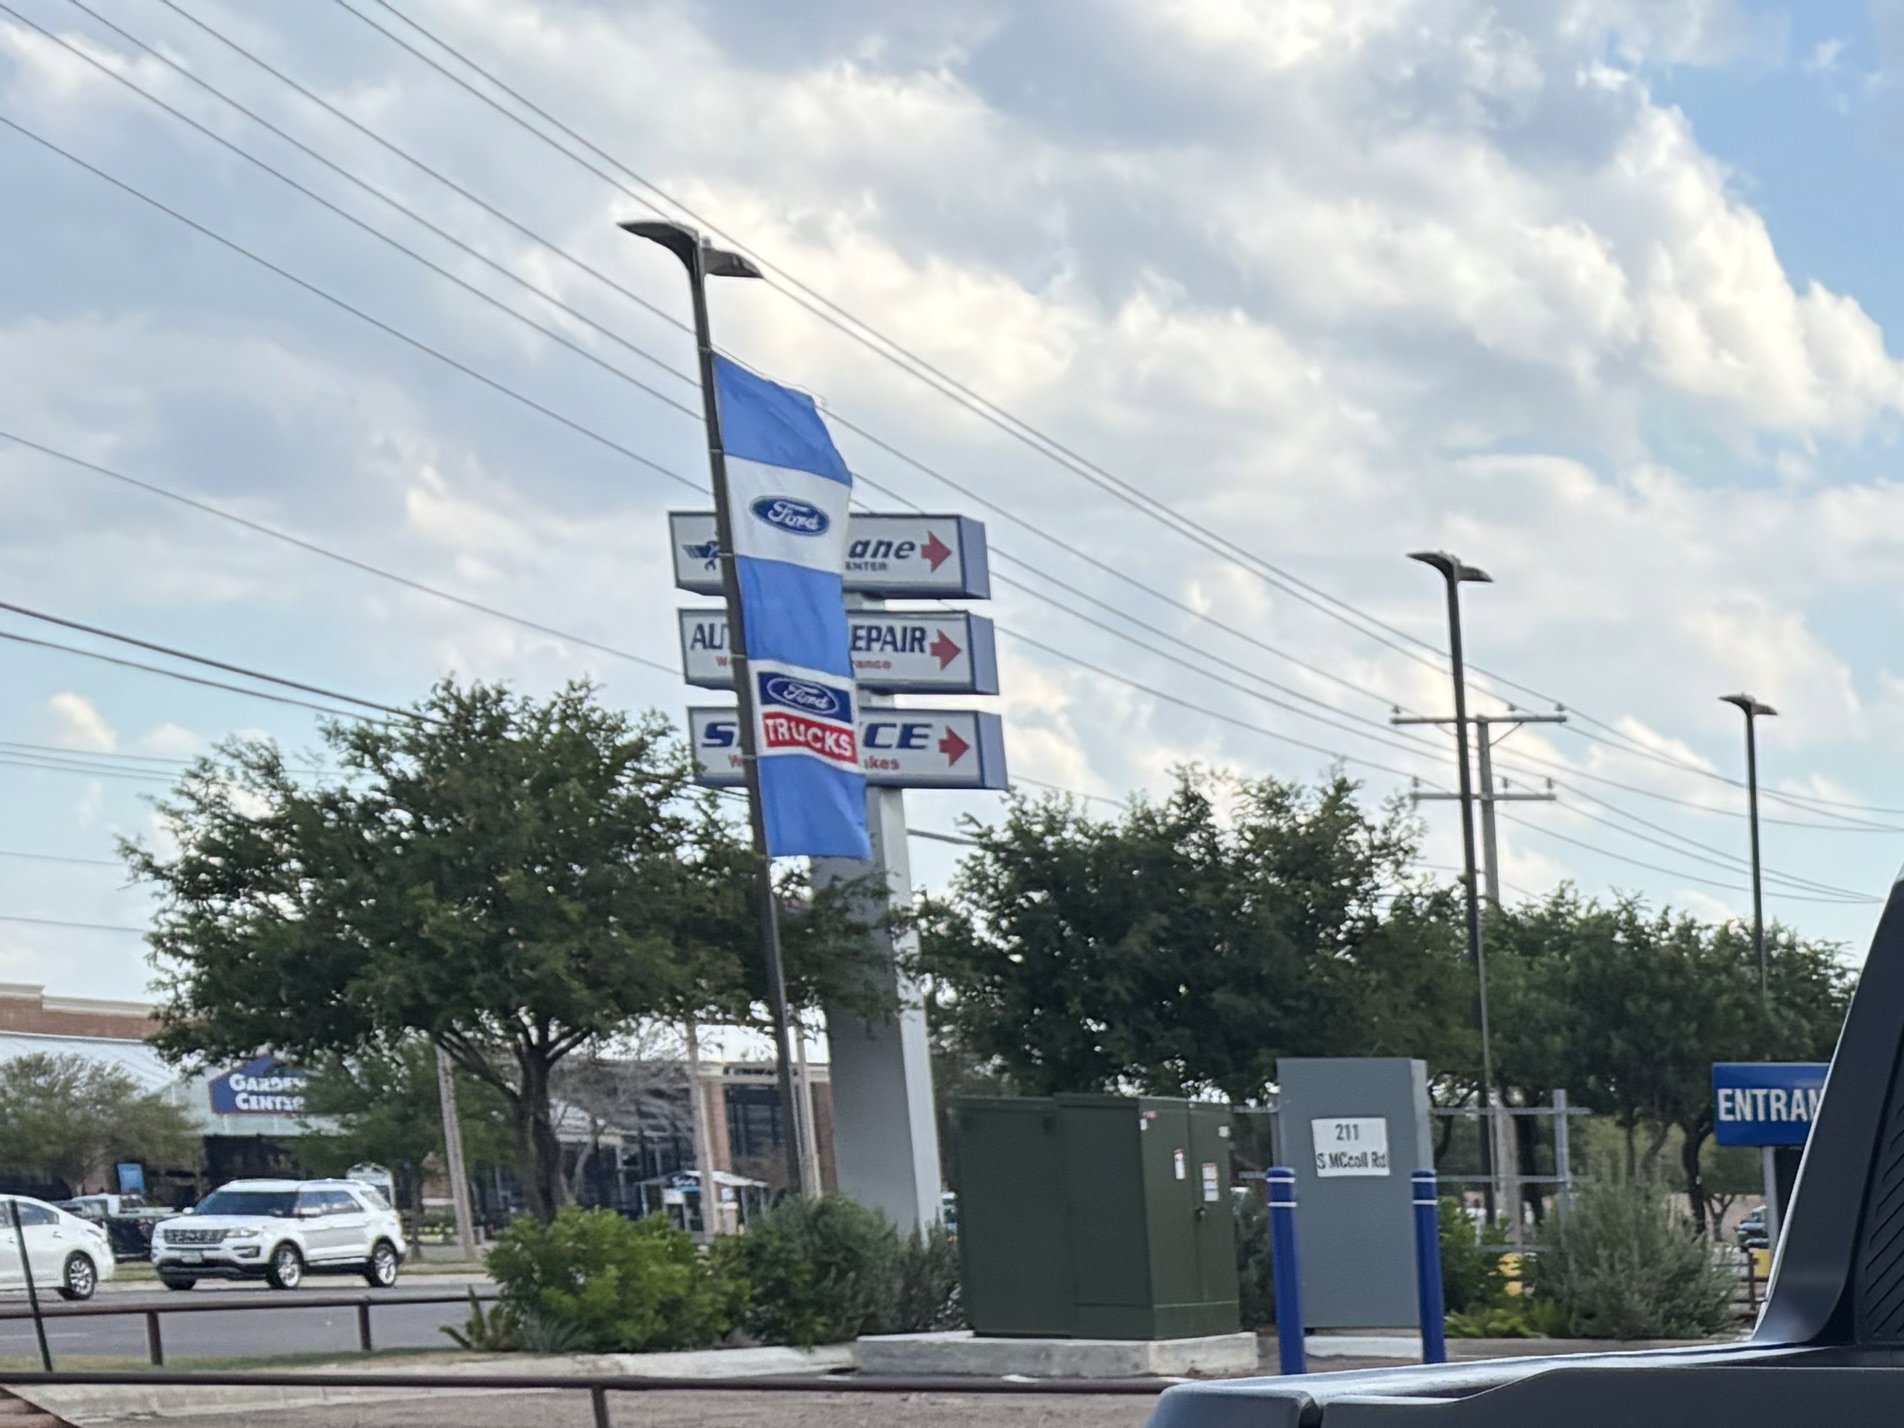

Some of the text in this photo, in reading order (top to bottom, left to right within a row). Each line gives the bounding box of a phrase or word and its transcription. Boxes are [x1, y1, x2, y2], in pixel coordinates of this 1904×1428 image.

[767, 500, 819, 530] Ford
[848, 539, 916, 559] ane
[845, 561, 888, 571] ENTER
[851, 624, 927, 653] EPAIR
[783, 683, 831, 710] Ford
[765, 717, 853, 757] TRUCKS
[1717, 1088, 1825, 1122] ENTRAN
[1335, 1123, 1360, 1141] 211
[1316, 1152, 1327, 1170] S
[1371, 1151, 1387, 1168] Rd
